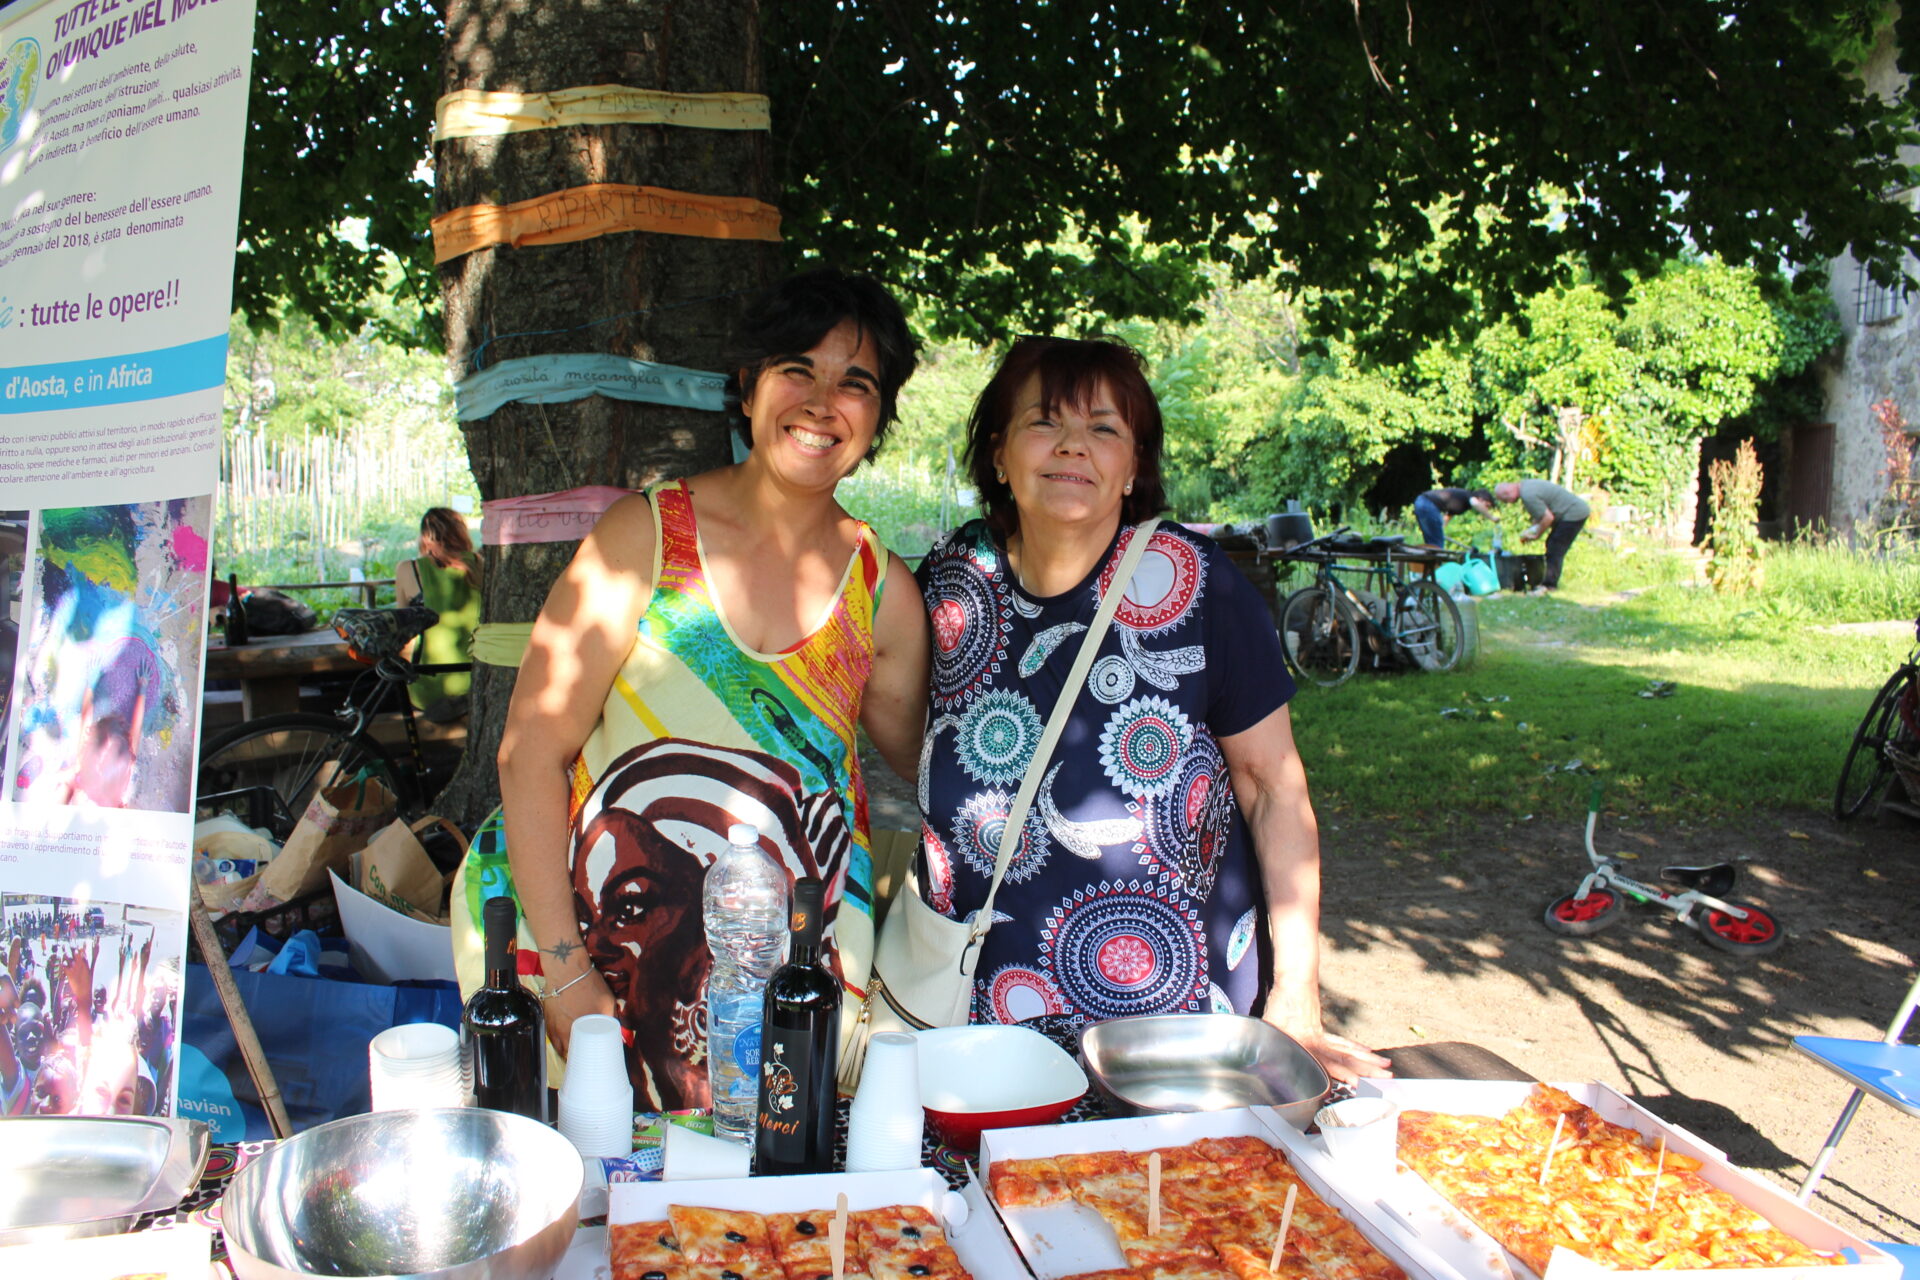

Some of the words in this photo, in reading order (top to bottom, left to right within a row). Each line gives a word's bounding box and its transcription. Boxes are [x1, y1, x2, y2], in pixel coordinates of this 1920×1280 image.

[46, 15, 129, 80] OVUNQUE
[129, 0, 166, 39] NEL
[54, 0, 99, 43] TUTTE
[171, 42, 198, 60] salute,
[106, 104, 146, 123] poniamo
[172, 79, 213, 102] qualsiasi
[86, 126, 122, 147] beneficio
[166, 106, 200, 123] umano.
[60, 192, 97, 210] genere:
[64, 211, 81, 226] del
[84, 205, 128, 225] benessere
[129, 194, 182, 214] dell'essere
[183, 183, 213, 203] umano.
[45, 235, 60, 251] del
[63, 232, 92, 248] 2018,
[101, 228, 121, 243] stata
[126, 214, 185, 236] denominata
[31, 300, 81, 328] tutte
[86, 292, 104, 321] le
[108, 279, 180, 323] opere!!
[5, 375, 69, 399] d'Aosta,
[74, 376, 84, 394] e
[88, 369, 104, 392] in
[107, 362, 153, 390] Africa
[565, 369, 663, 390] meraviglia
[46, 444, 70, 456] oppure
[46, 456, 75, 468] mediche
[24, 472, 60, 483] attenzione
[758, 1111, 800, 1136] Merci
